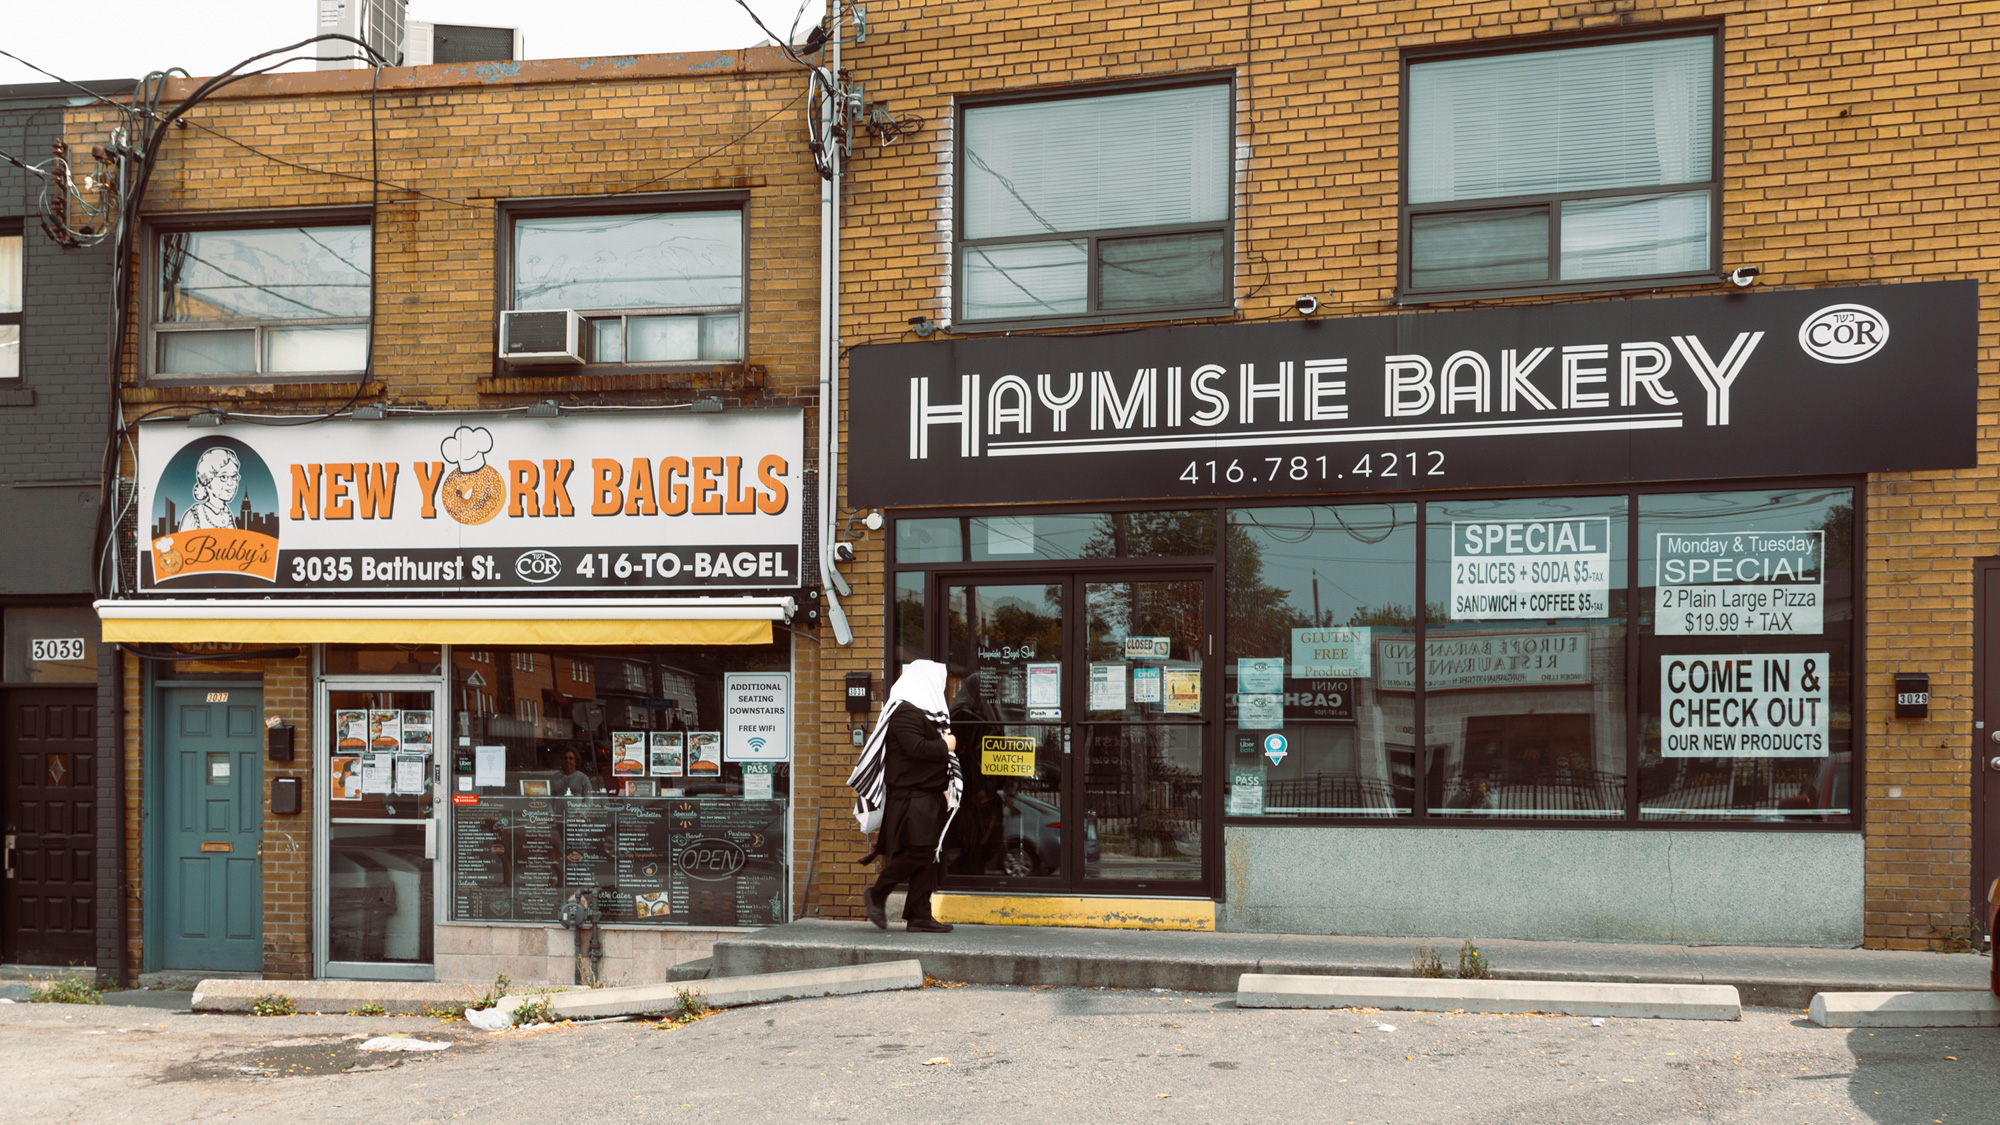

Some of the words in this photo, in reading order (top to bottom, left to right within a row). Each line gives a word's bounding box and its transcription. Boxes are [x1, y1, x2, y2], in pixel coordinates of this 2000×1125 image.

[909, 357, 1349, 460] HAYMISHE
[1384, 331, 1766, 427] BAKERY
[1179, 450, 1446, 485] 416.781.4212
[289, 461, 400, 521] NEW
[591, 453, 789, 518] BAGELS
[1464, 522, 1597, 555] SPECIAL
[1668, 537, 1728, 554] Monday
[1732, 537, 1744, 551] &
[1748, 535, 1816, 554] Tuesday
[184, 535, 271, 572] Bubby's
[291, 556, 354, 582] 3035
[362, 555, 464, 582] Bathurst
[471, 554, 501, 581] St.
[576, 551, 789, 579] 416-TO-BAGEL
[1456, 563, 1464, 584] 2
[1468, 562, 1516, 584] SLICES
[1520, 565, 1528, 581] +
[1532, 560, 1570, 584] SODA
[1664, 557, 1816, 583] SPECIAL
[1456, 594, 1517, 612] SANDWICH
[1520, 597, 1526, 610] +
[1530, 594, 1575, 612] COFFEE
[1663, 591, 1672, 608] 2
[1677, 590, 1718, 608] Plain
[1722, 590, 1768, 612] Large
[1773, 588, 1816, 608] Pizza
[1685, 612, 1739, 633] $19.99
[1744, 616, 1754, 628] +
[1760, 612, 1793, 632] TAX
[1126, 639, 1153, 650] CLOSED
[1300, 631, 1361, 644] GLUTEN
[34, 640, 83, 660] 3039
[1314, 648, 1349, 660] FREE
[1304, 666, 1358, 677] Products
[1668, 659, 1753, 694] COME
[1763, 659, 1790, 692] IN
[1800, 658, 1822, 692] &
[207, 693, 227, 702] 3037
[849, 688, 866, 696] 3031
[1900, 693, 1928, 704] 3029
[1668, 698, 1760, 728] CHECK
[1767, 698, 1821, 727] OUT
[985, 740, 1032, 751] CAUTION
[1668, 734, 1699, 751] OUR
[1704, 734, 1737, 750] NEW
[1741, 733, 1822, 751] PRODUCTS
[993, 754, 1024, 763] WATCH
[747, 765, 768, 773] PASS
[984, 764, 1008, 772] YOUR
[1011, 765, 1031, 773] STEP
[1235, 776, 1259, 786] PASS
[682, 850, 739, 870] OPEN
[612, 890, 632, 899] Cater
